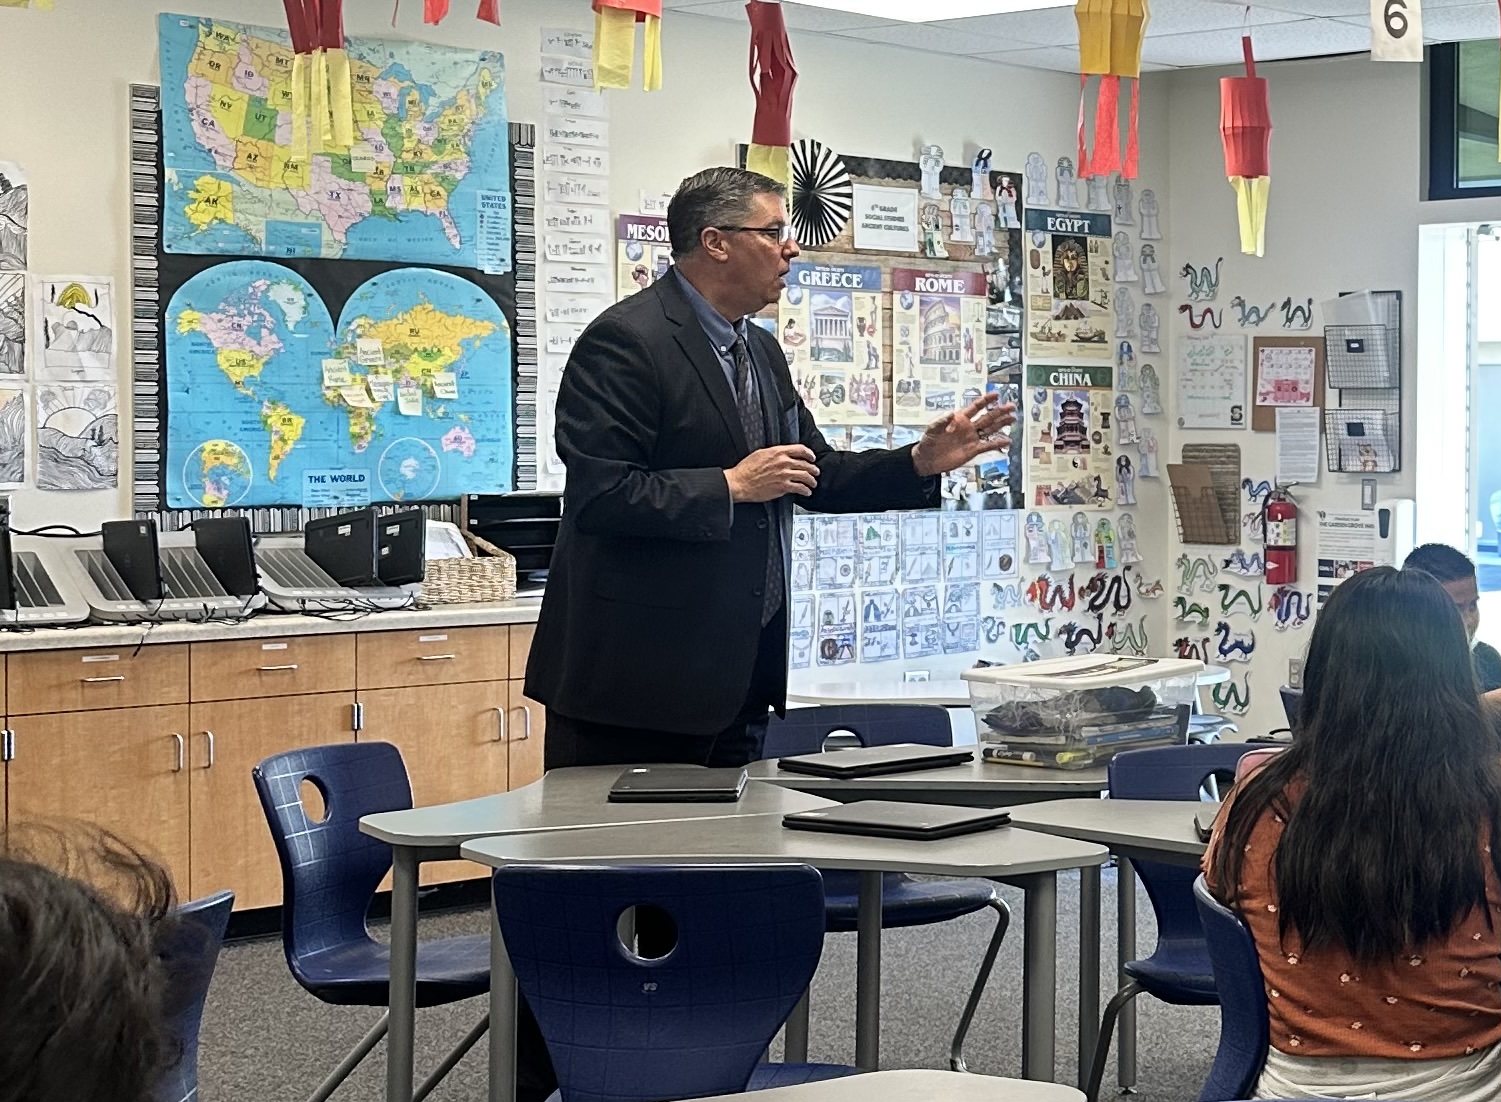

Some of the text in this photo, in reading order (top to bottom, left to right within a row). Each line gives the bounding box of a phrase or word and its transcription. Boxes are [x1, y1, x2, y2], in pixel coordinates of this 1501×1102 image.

[1384, 0, 1408, 39] 6
[201, 118, 215, 128] CA
[254, 113, 267, 122] UT
[481, 195, 506, 203] UNITED
[481, 202, 507, 210] STATES
[1047, 216, 1091, 233] EGYPT
[798, 270, 863, 288] GREECE
[915, 277, 965, 294] ROME
[1049, 372, 1092, 386] CHINA
[308, 474, 366, 483] THE WORLD
